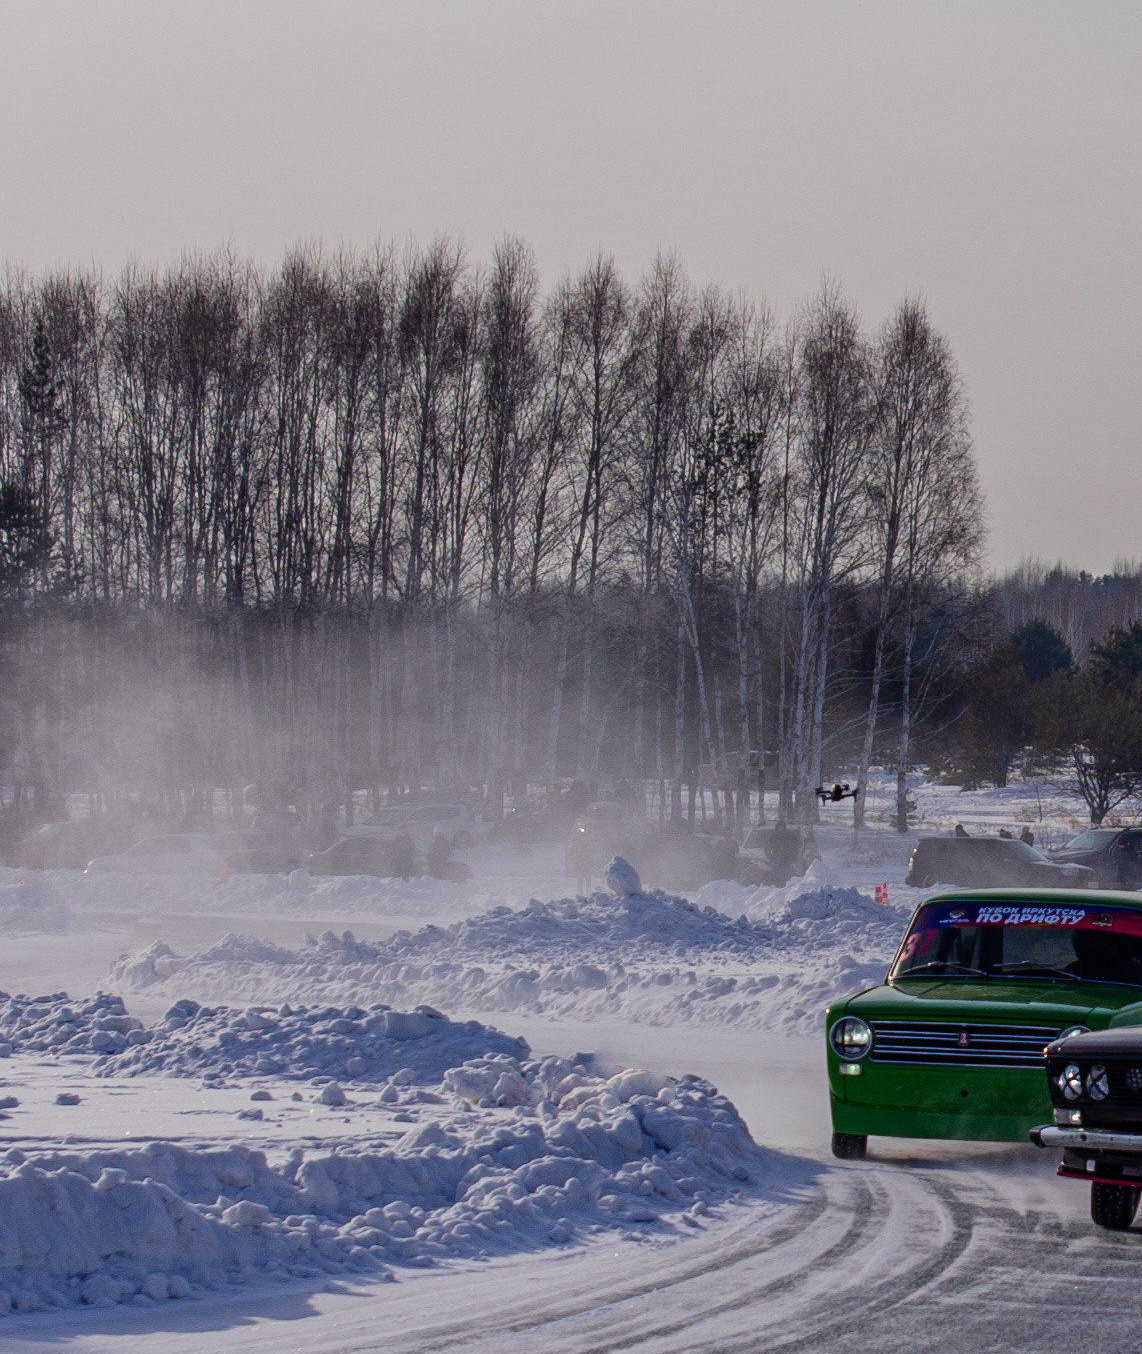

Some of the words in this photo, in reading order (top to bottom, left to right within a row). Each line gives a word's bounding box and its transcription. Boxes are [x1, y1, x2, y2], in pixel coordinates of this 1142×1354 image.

[978, 906, 1020, 915] КУБОК
[1021, 907, 1086, 917] ИРКУТСКА
[975, 913, 1004, 924] ПО
[1004, 914, 1086, 926] ДРИФТУ
